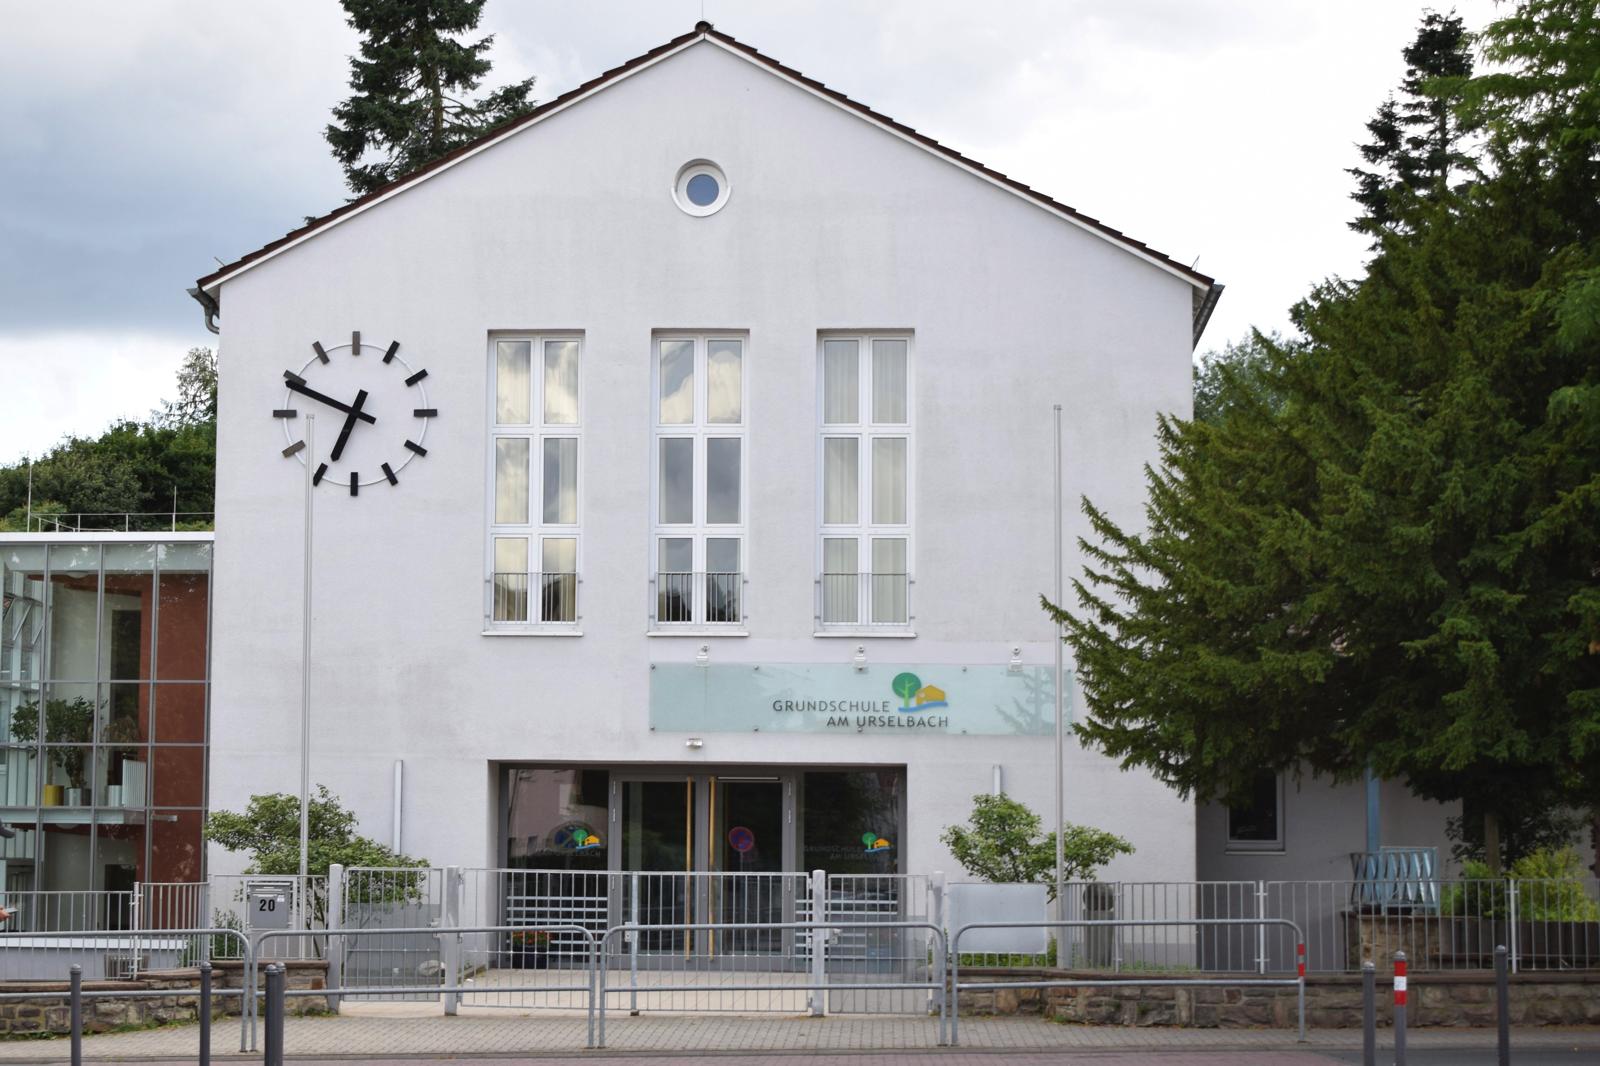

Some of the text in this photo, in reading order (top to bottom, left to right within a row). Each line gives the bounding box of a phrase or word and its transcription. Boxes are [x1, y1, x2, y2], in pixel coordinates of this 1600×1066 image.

[772, 700, 890, 713] GRUNDSCHULE
[826, 715, 948, 728] AM URSELBACH
[259, 899, 275, 912] 20
